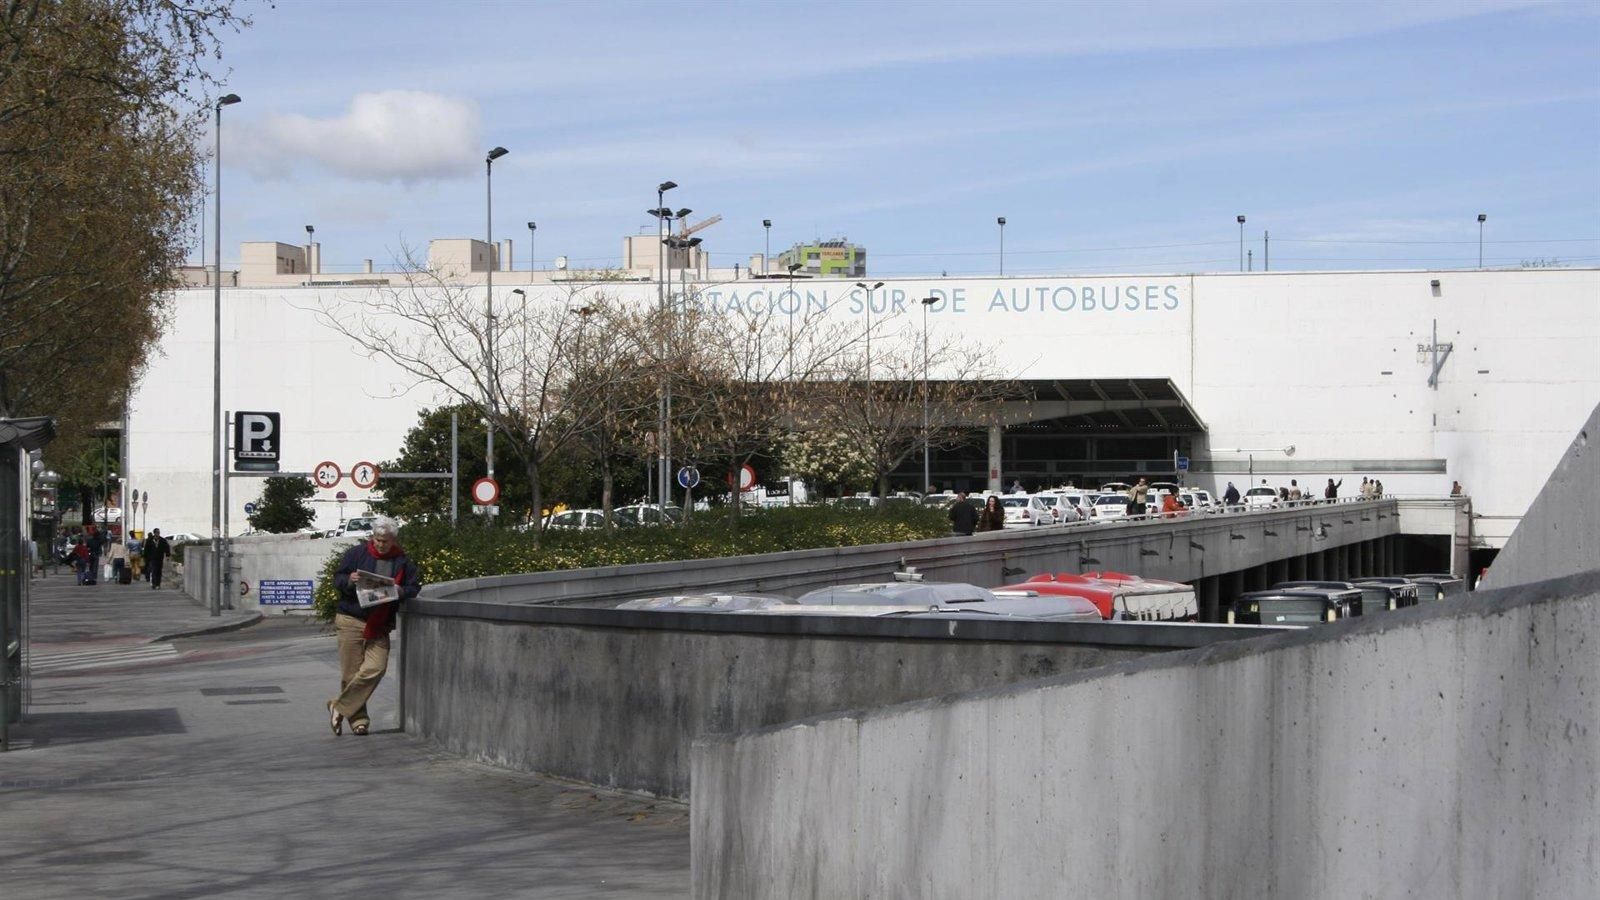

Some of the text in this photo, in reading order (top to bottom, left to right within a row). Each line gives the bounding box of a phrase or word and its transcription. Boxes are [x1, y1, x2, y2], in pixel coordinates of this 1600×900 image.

[849, 289, 906, 314] SUR
[930, 288, 966, 313] DE
[988, 285, 1179, 313] AUTOBUSES
[242, 414, 273, 451] P
